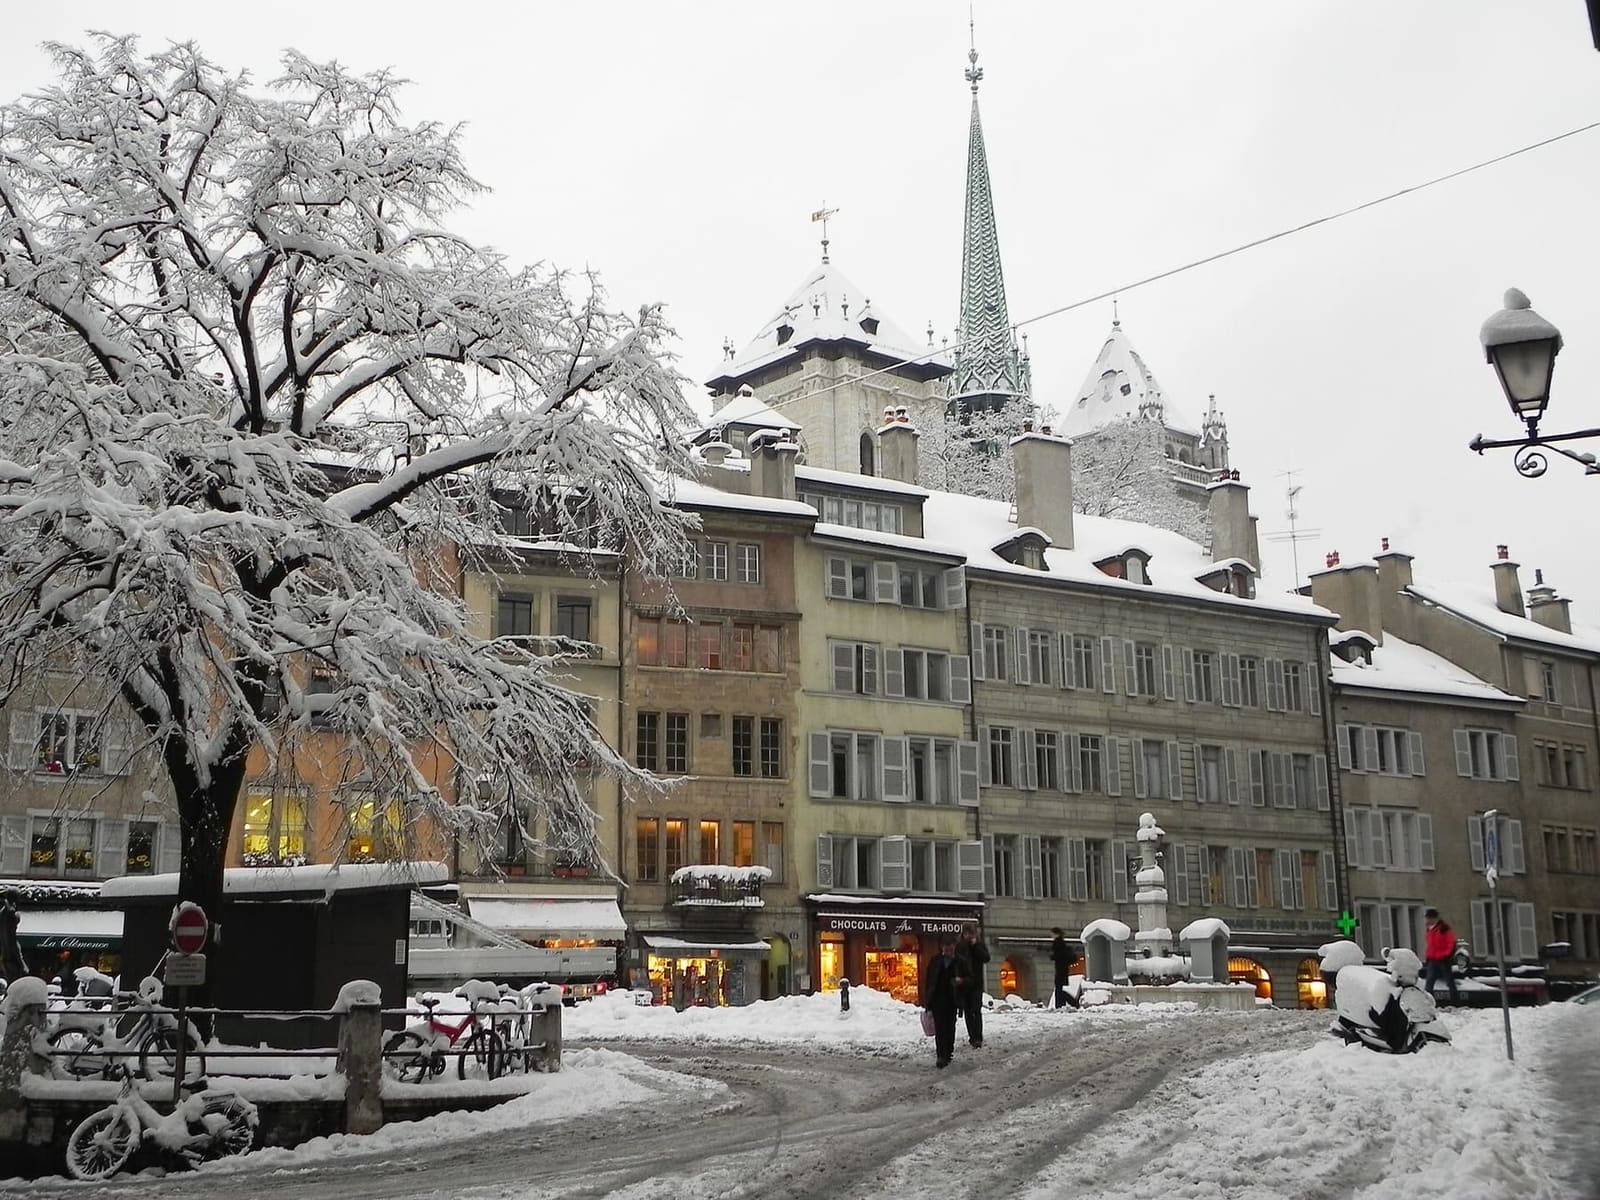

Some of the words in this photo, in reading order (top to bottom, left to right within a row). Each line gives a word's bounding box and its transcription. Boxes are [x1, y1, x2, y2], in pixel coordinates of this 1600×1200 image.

[830, 919, 887, 931] CHOCOLATS
[921, 923, 963, 934] TEA-ROO
[36, 936, 57, 948] La
